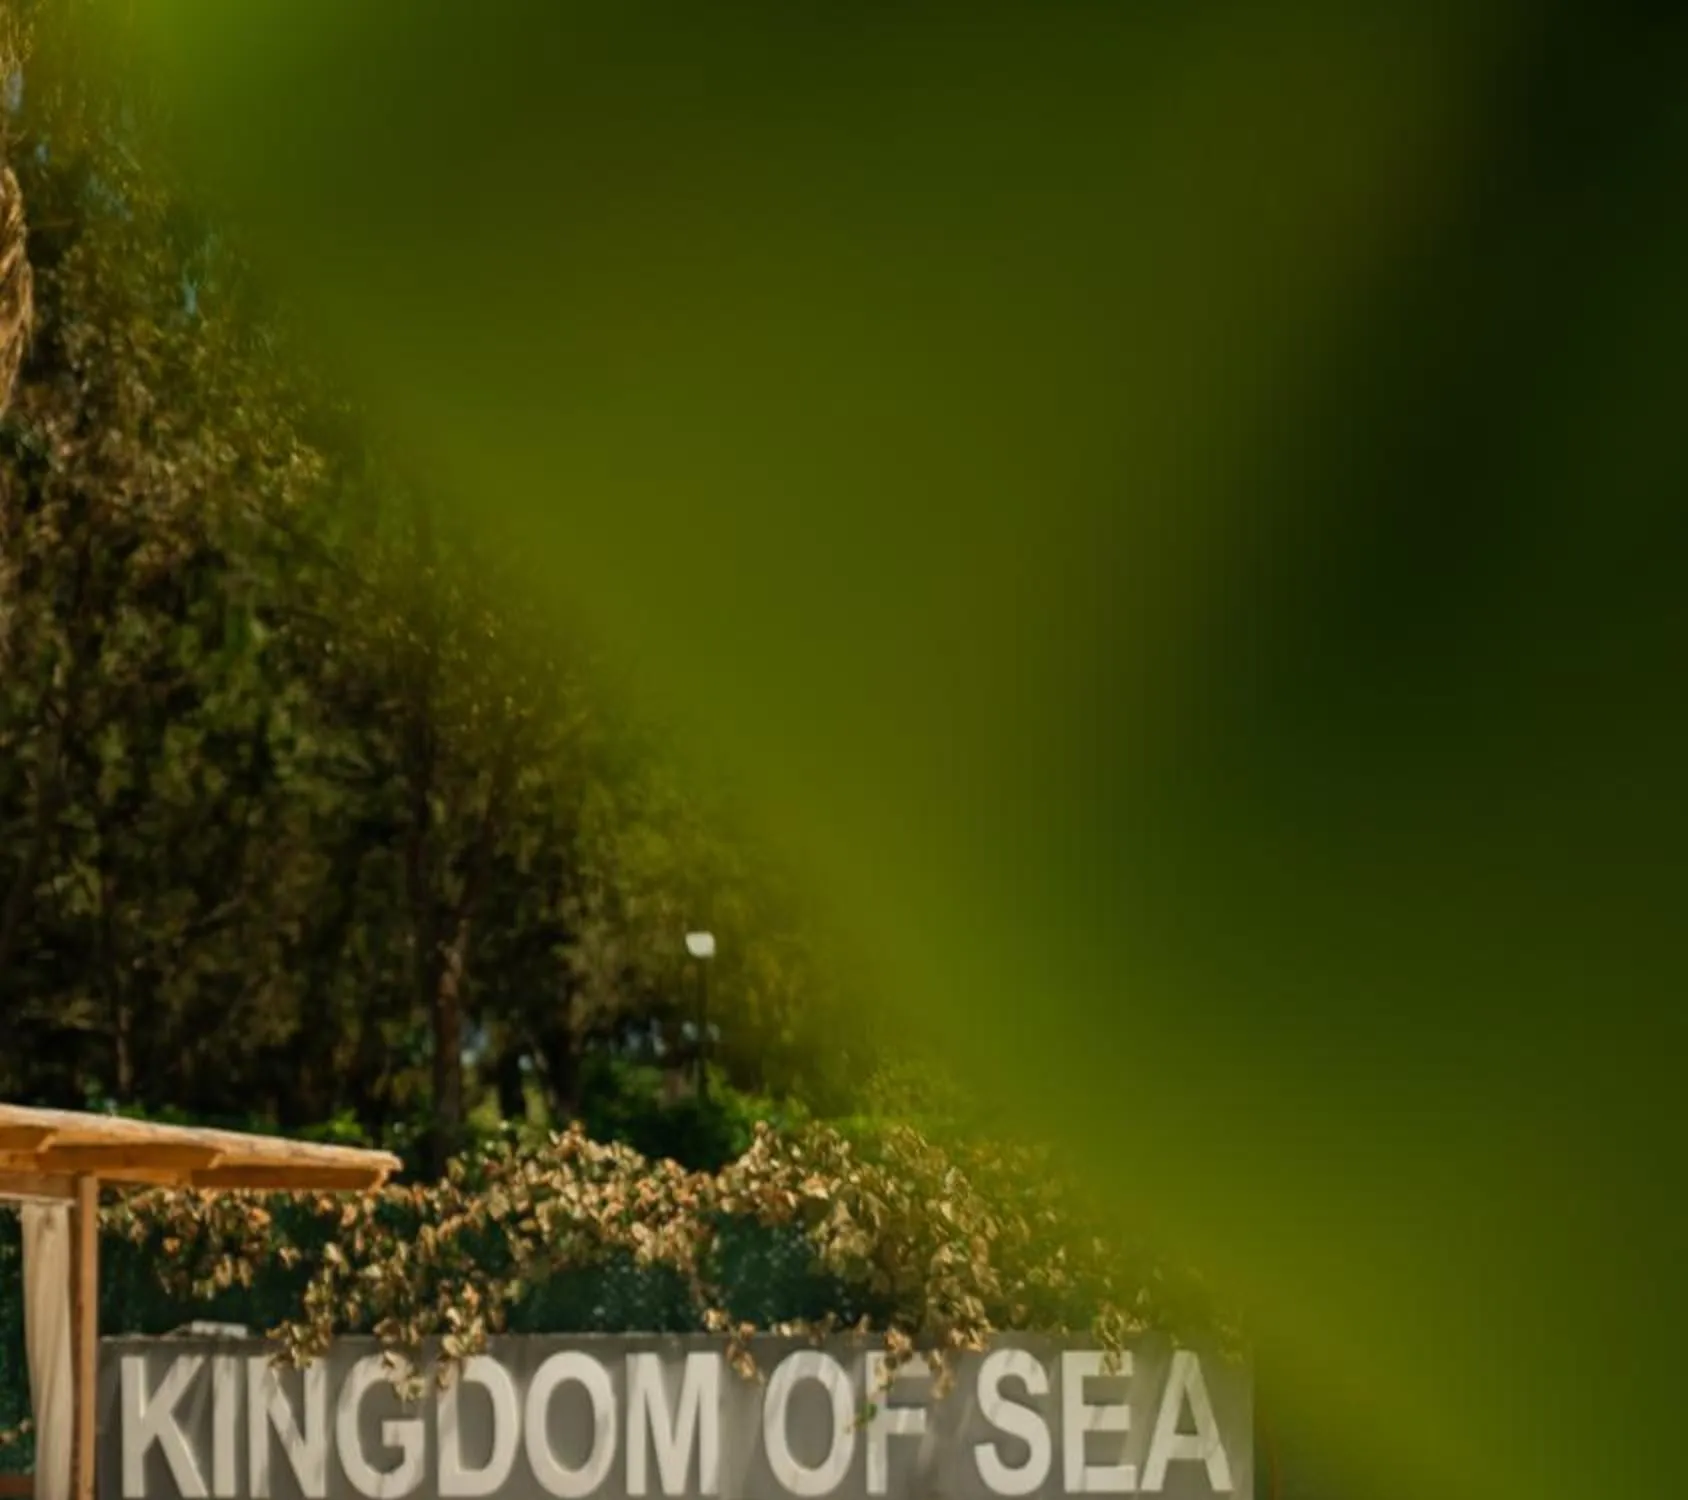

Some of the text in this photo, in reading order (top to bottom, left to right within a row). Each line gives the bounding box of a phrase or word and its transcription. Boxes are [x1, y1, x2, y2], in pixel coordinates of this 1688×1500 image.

[121, 1350, 1233, 1500] KINGDOM OF SEA
